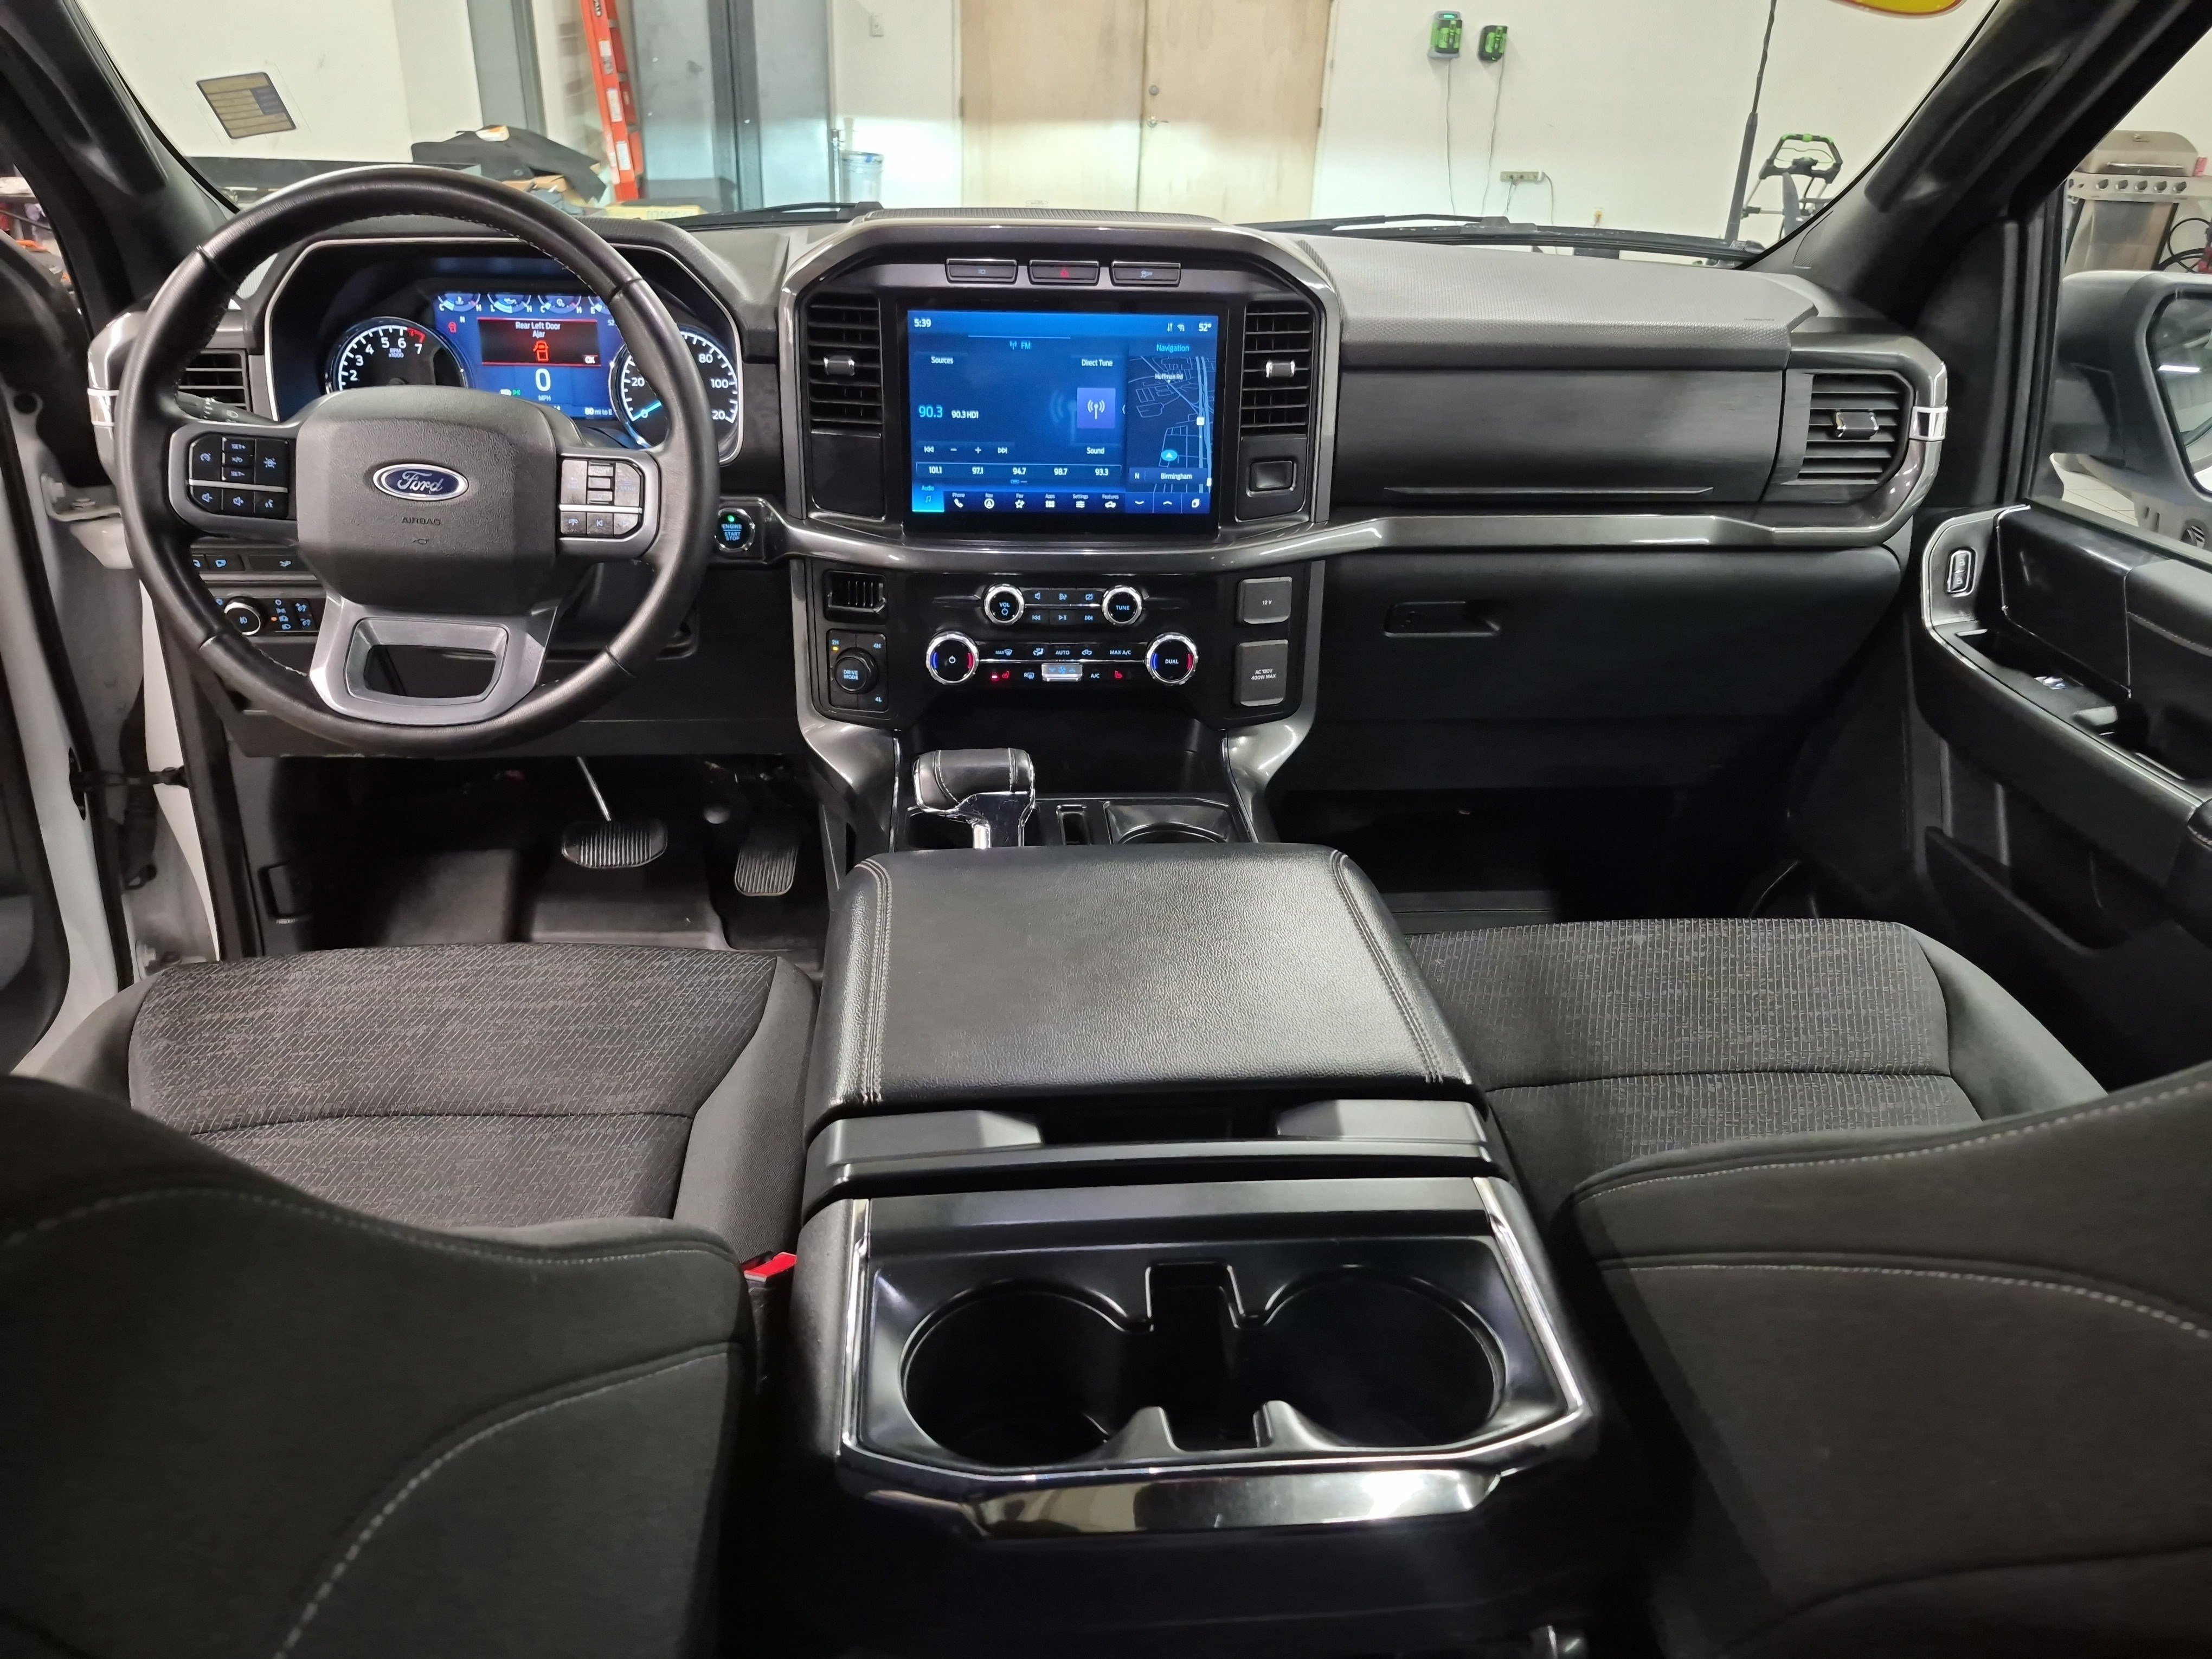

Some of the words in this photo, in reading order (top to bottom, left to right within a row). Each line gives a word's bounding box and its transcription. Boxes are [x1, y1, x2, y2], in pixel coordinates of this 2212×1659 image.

[516, 321, 530, 330] Rear
[531, 321, 545, 330] Left
[546, 322, 561, 330] Door
[914, 318, 931, 328] 5:39
[532, 330, 545, 338] Ajar
[381, 337, 390, 348] 5
[397, 337, 407, 349] 6
[1021, 342, 1031, 350] FM
[365, 344, 374, 355] 4
[414, 343, 422, 354] 7
[1156, 344, 1189, 353] Navigation
[355, 355, 364, 366] 3
[584, 356, 595, 364] OK
[698, 353, 713, 363] 80
[931, 356, 954, 365] Sources
[1081, 358, 1097, 367] Direct
[1098, 359, 1113, 368] Tune
[349, 370, 358, 381] 2
[535, 368, 551, 391] 0
[631, 377, 645, 387] 20
[710, 378, 729, 388] 100
[712, 410, 726, 420] 20
[918, 405, 943, 419] 90.3
[951, 410, 967, 419] 90.3
[967, 410, 979, 419] HD1
[1086, 447, 1105, 455] Sound
[929, 466, 942, 474] 101.1
[972, 467, 983, 475] 97.1
[1054, 467, 1068, 475] 98.7
[397, 471, 445, 492] Ford
[1161, 473, 1192, 481] Birmingham
